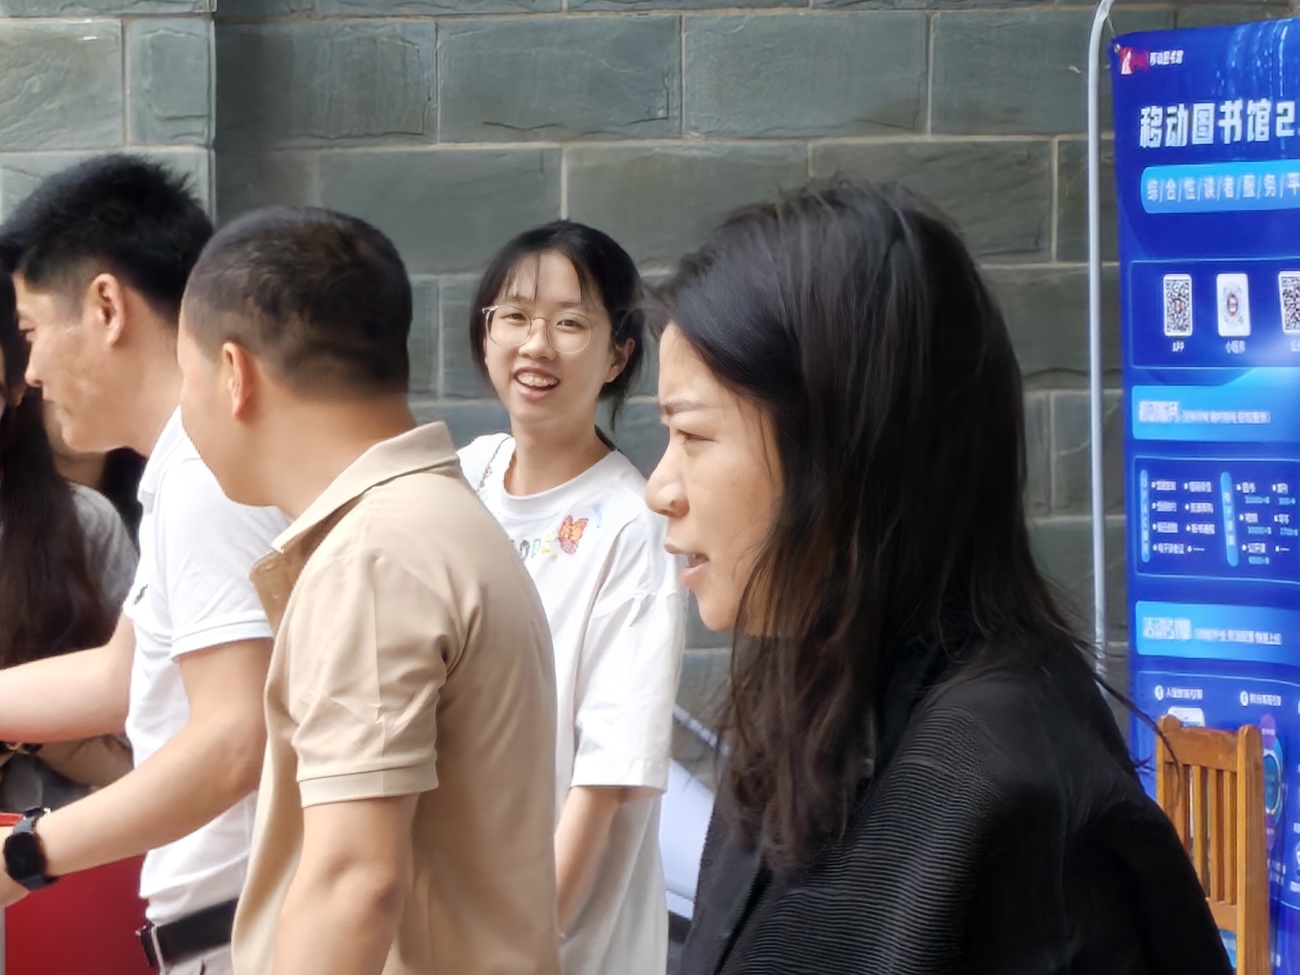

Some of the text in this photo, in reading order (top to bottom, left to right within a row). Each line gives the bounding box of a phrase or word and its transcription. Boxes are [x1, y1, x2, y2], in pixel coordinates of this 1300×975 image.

[1139, 98, 1300, 148] 移动图书馆2
